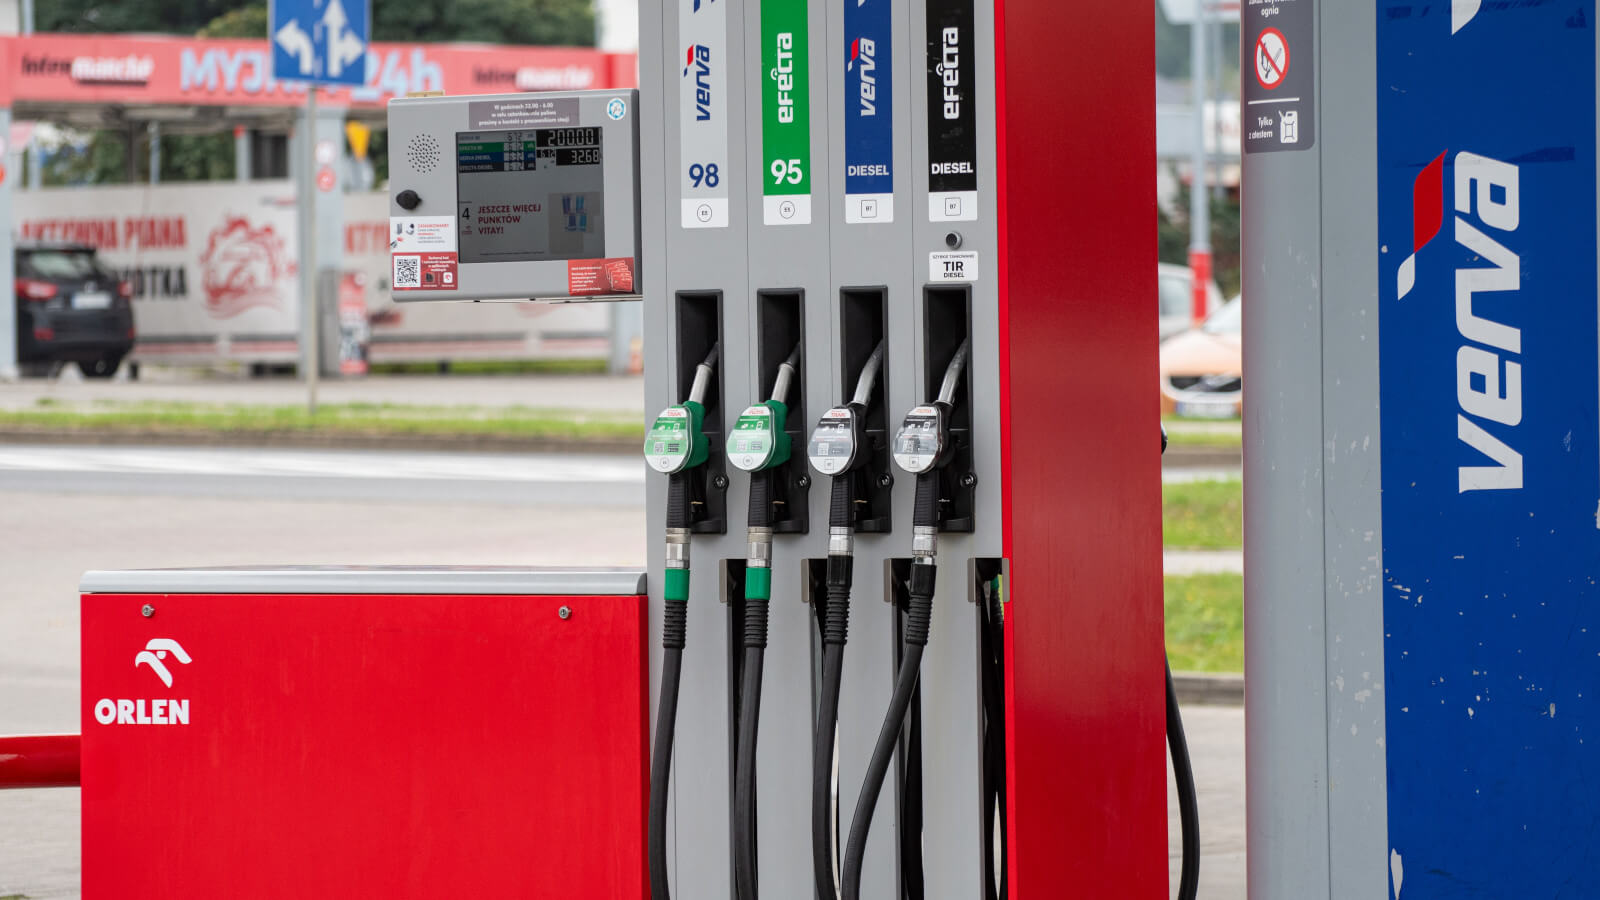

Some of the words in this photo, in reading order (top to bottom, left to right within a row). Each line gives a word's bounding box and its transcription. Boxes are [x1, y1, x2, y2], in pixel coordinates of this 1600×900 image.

[1261, 5, 1279, 18] ognia
[696, 44, 711, 121] verva
[860, 37, 876, 117] verva
[1258, 117, 1273, 129] Tylko
[771, 159, 802, 184] 95
[848, 164, 889, 177] DIESEL
[931, 161, 973, 175] DIESEL
[689, 163, 719, 188] 98
[462, 208, 470, 221] 4
[478, 205, 510, 214] JESZCZE
[513, 203, 541, 214] WIĘCEJ
[478, 213, 521, 224] PUNKTÓW
[478, 226, 504, 236] VITAY!
[943, 261, 964, 272] TIR
[1454, 151, 1524, 494] verva
[94, 698, 190, 725] ORLEN
